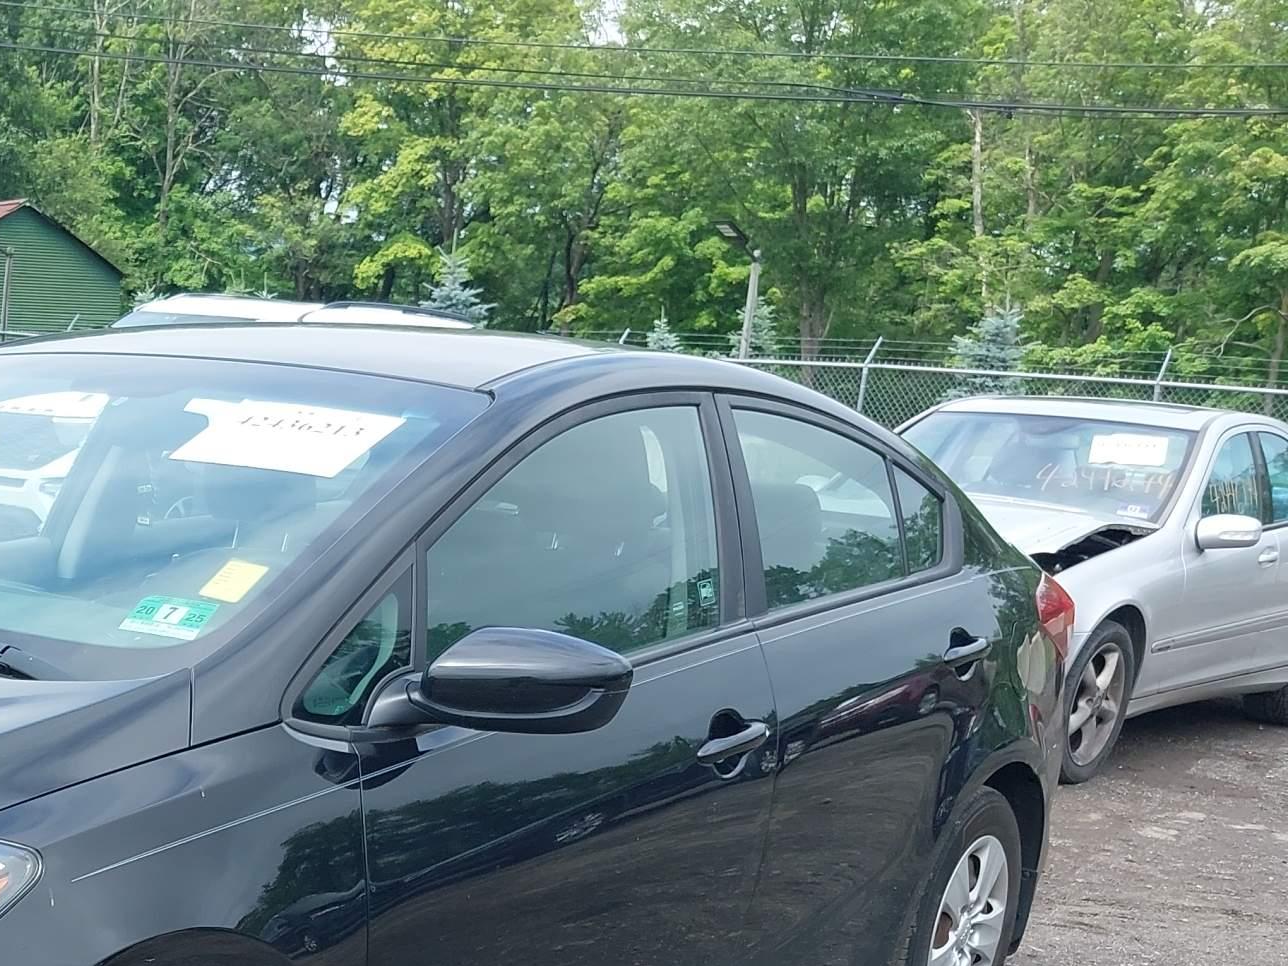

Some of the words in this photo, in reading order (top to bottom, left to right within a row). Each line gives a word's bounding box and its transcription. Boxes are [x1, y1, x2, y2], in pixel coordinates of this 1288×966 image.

[136, 605, 156, 616] 20
[162, 606, 179, 620] 7
[185, 613, 205, 624] 25
